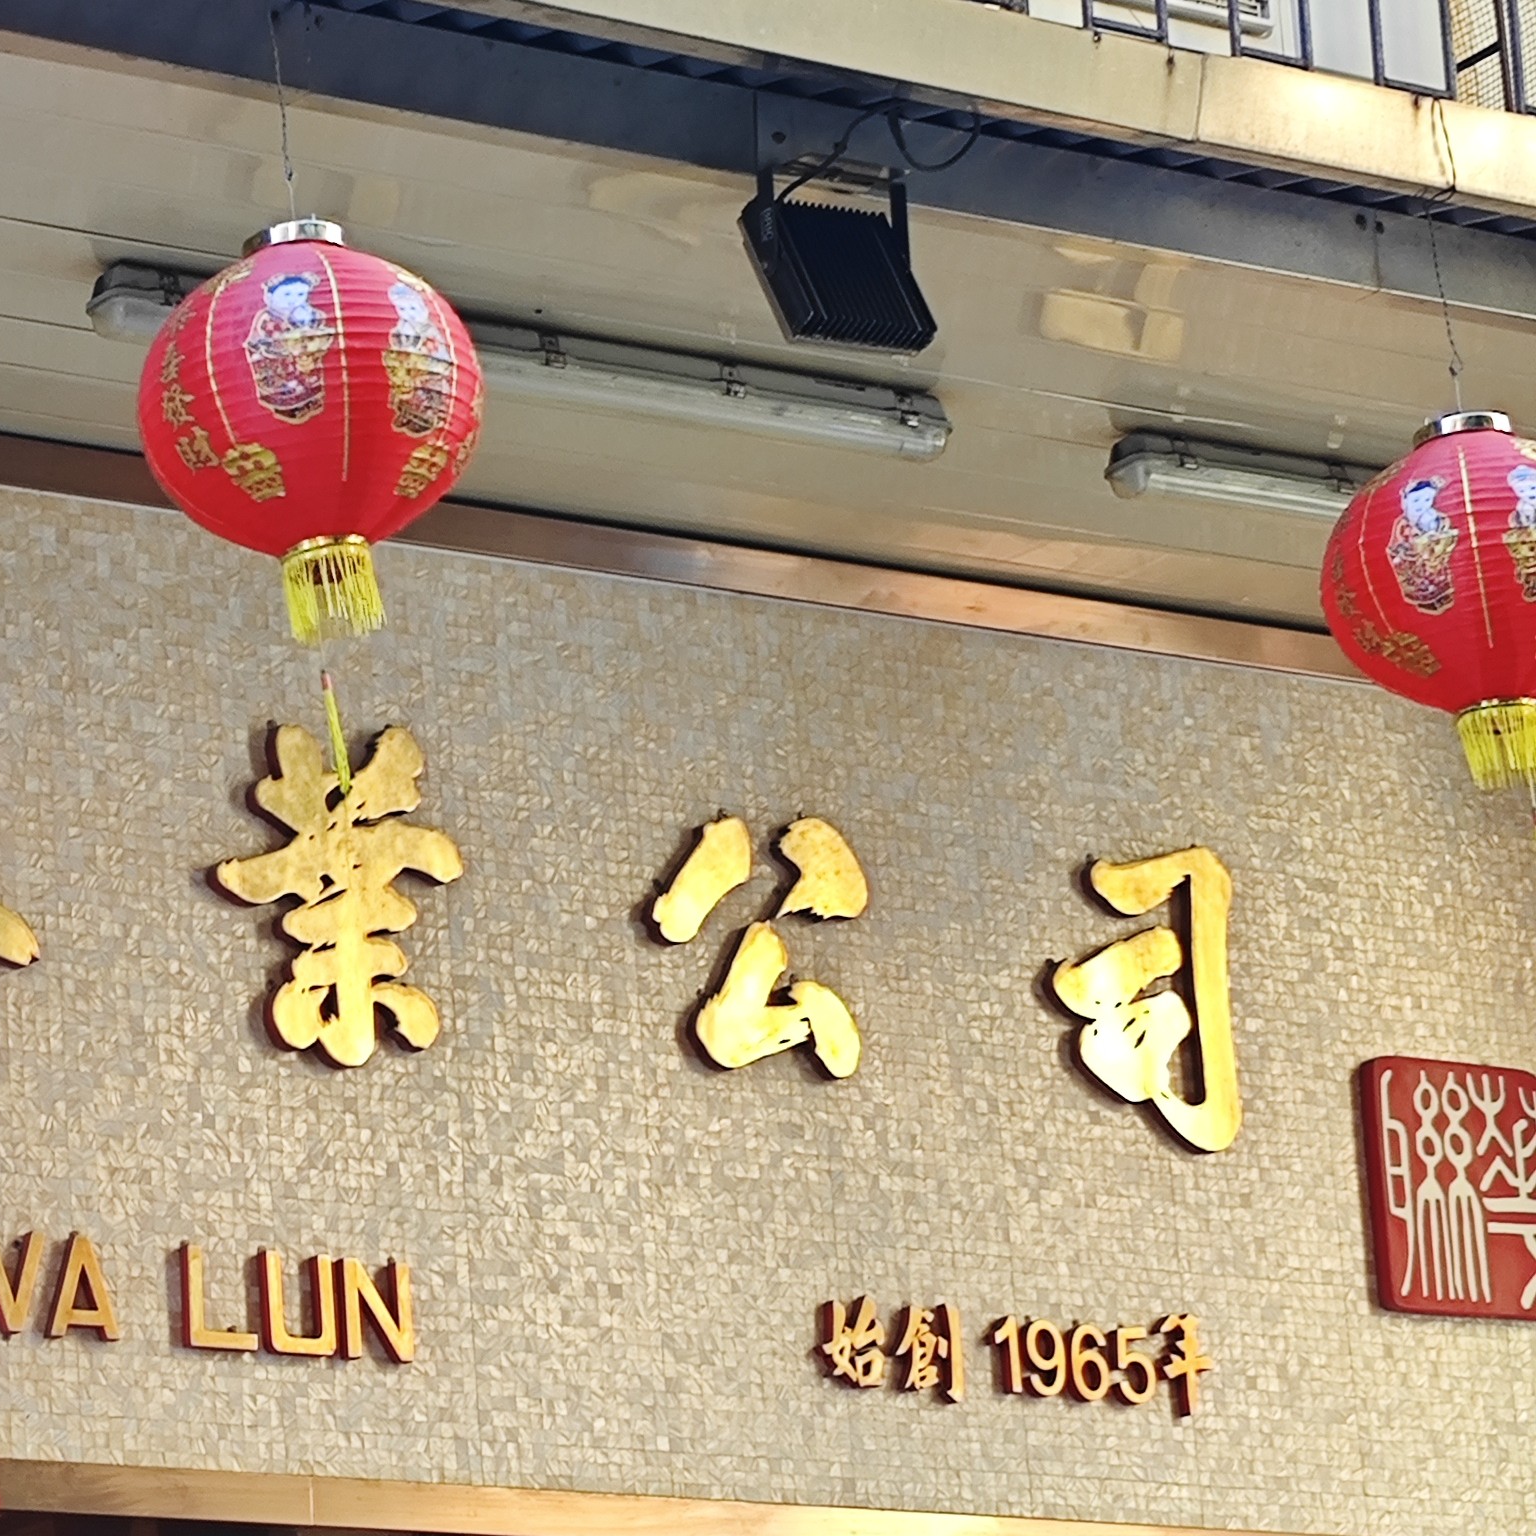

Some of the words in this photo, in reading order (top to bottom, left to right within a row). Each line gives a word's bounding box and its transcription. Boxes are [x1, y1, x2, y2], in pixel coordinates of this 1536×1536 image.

[179, 1241, 416, 1363] LUN
[814, 1296, 965, 1403] 始創
[990, 1311, 1214, 1417] 1965年
